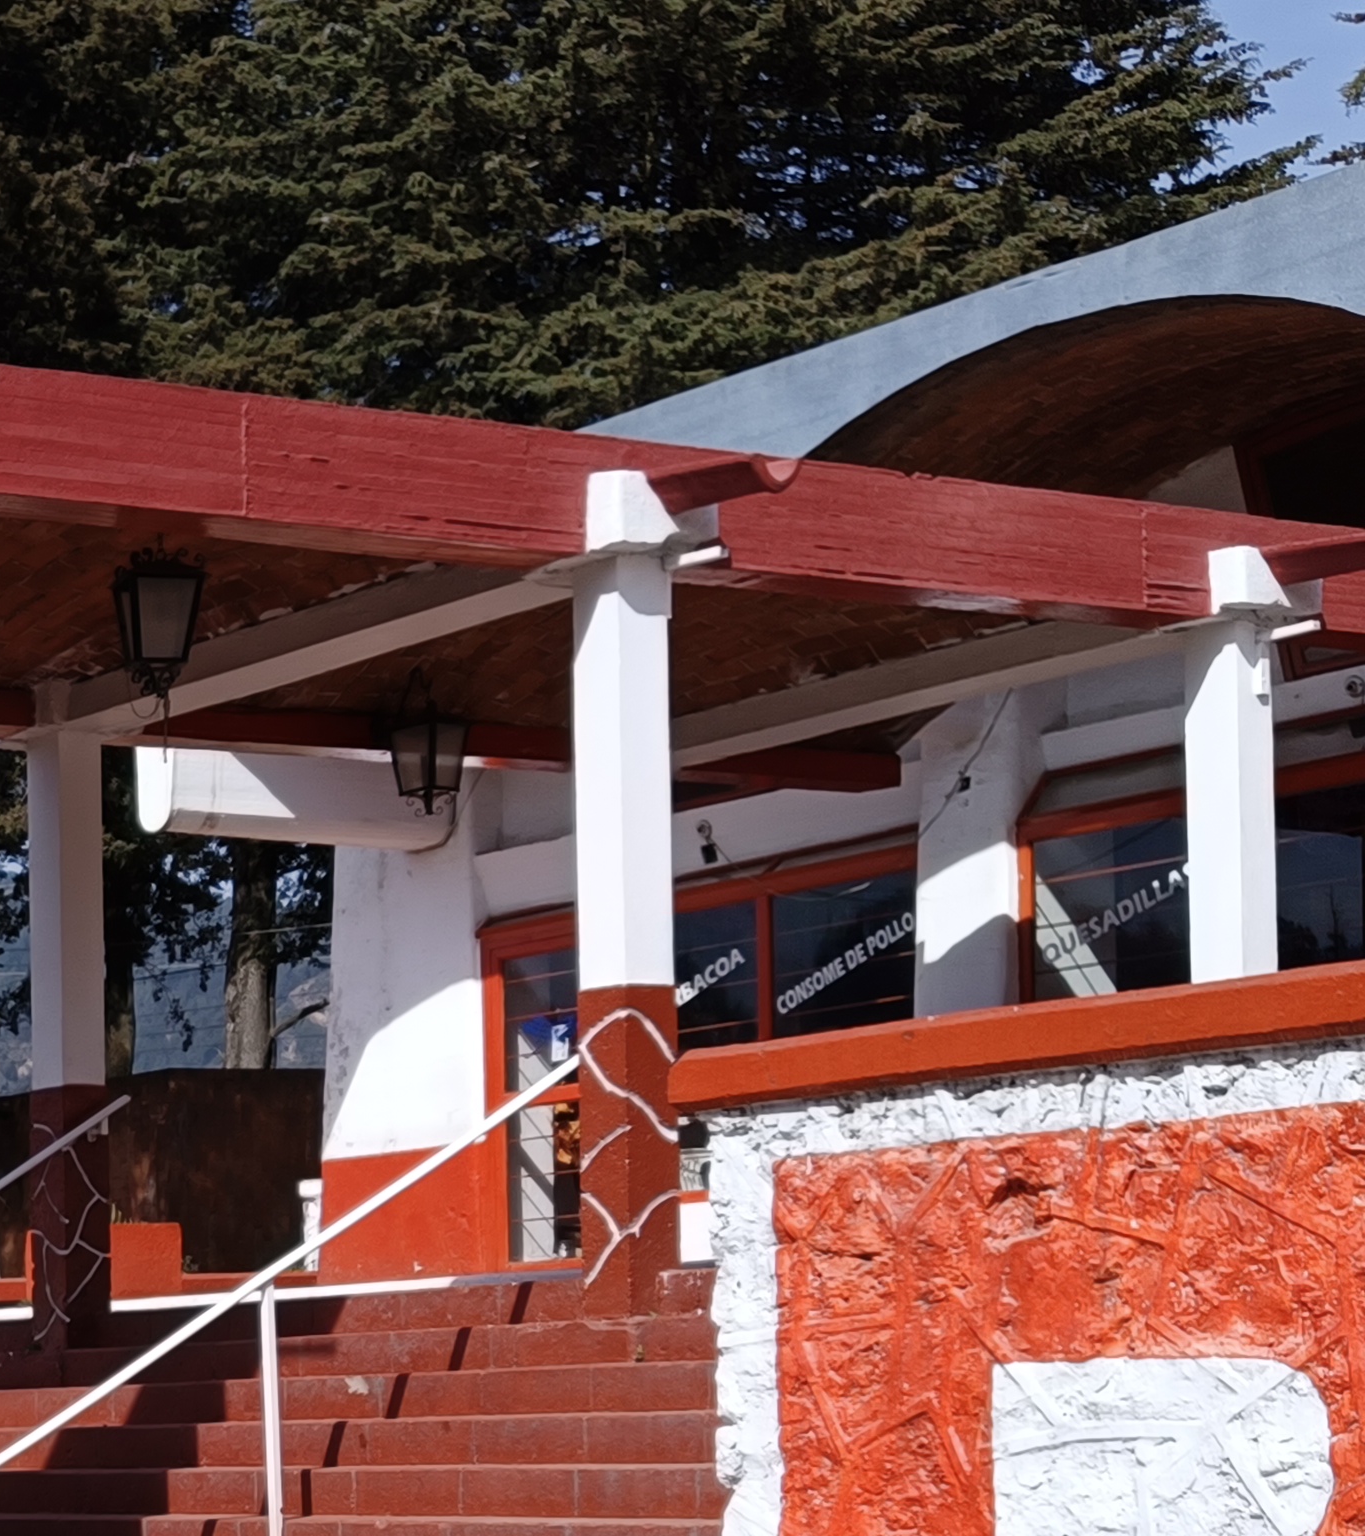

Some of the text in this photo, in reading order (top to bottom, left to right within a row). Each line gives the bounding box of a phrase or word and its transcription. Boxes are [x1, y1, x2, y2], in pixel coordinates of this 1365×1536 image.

[775, 911, 916, 1016] CONSOME DE POLLO
